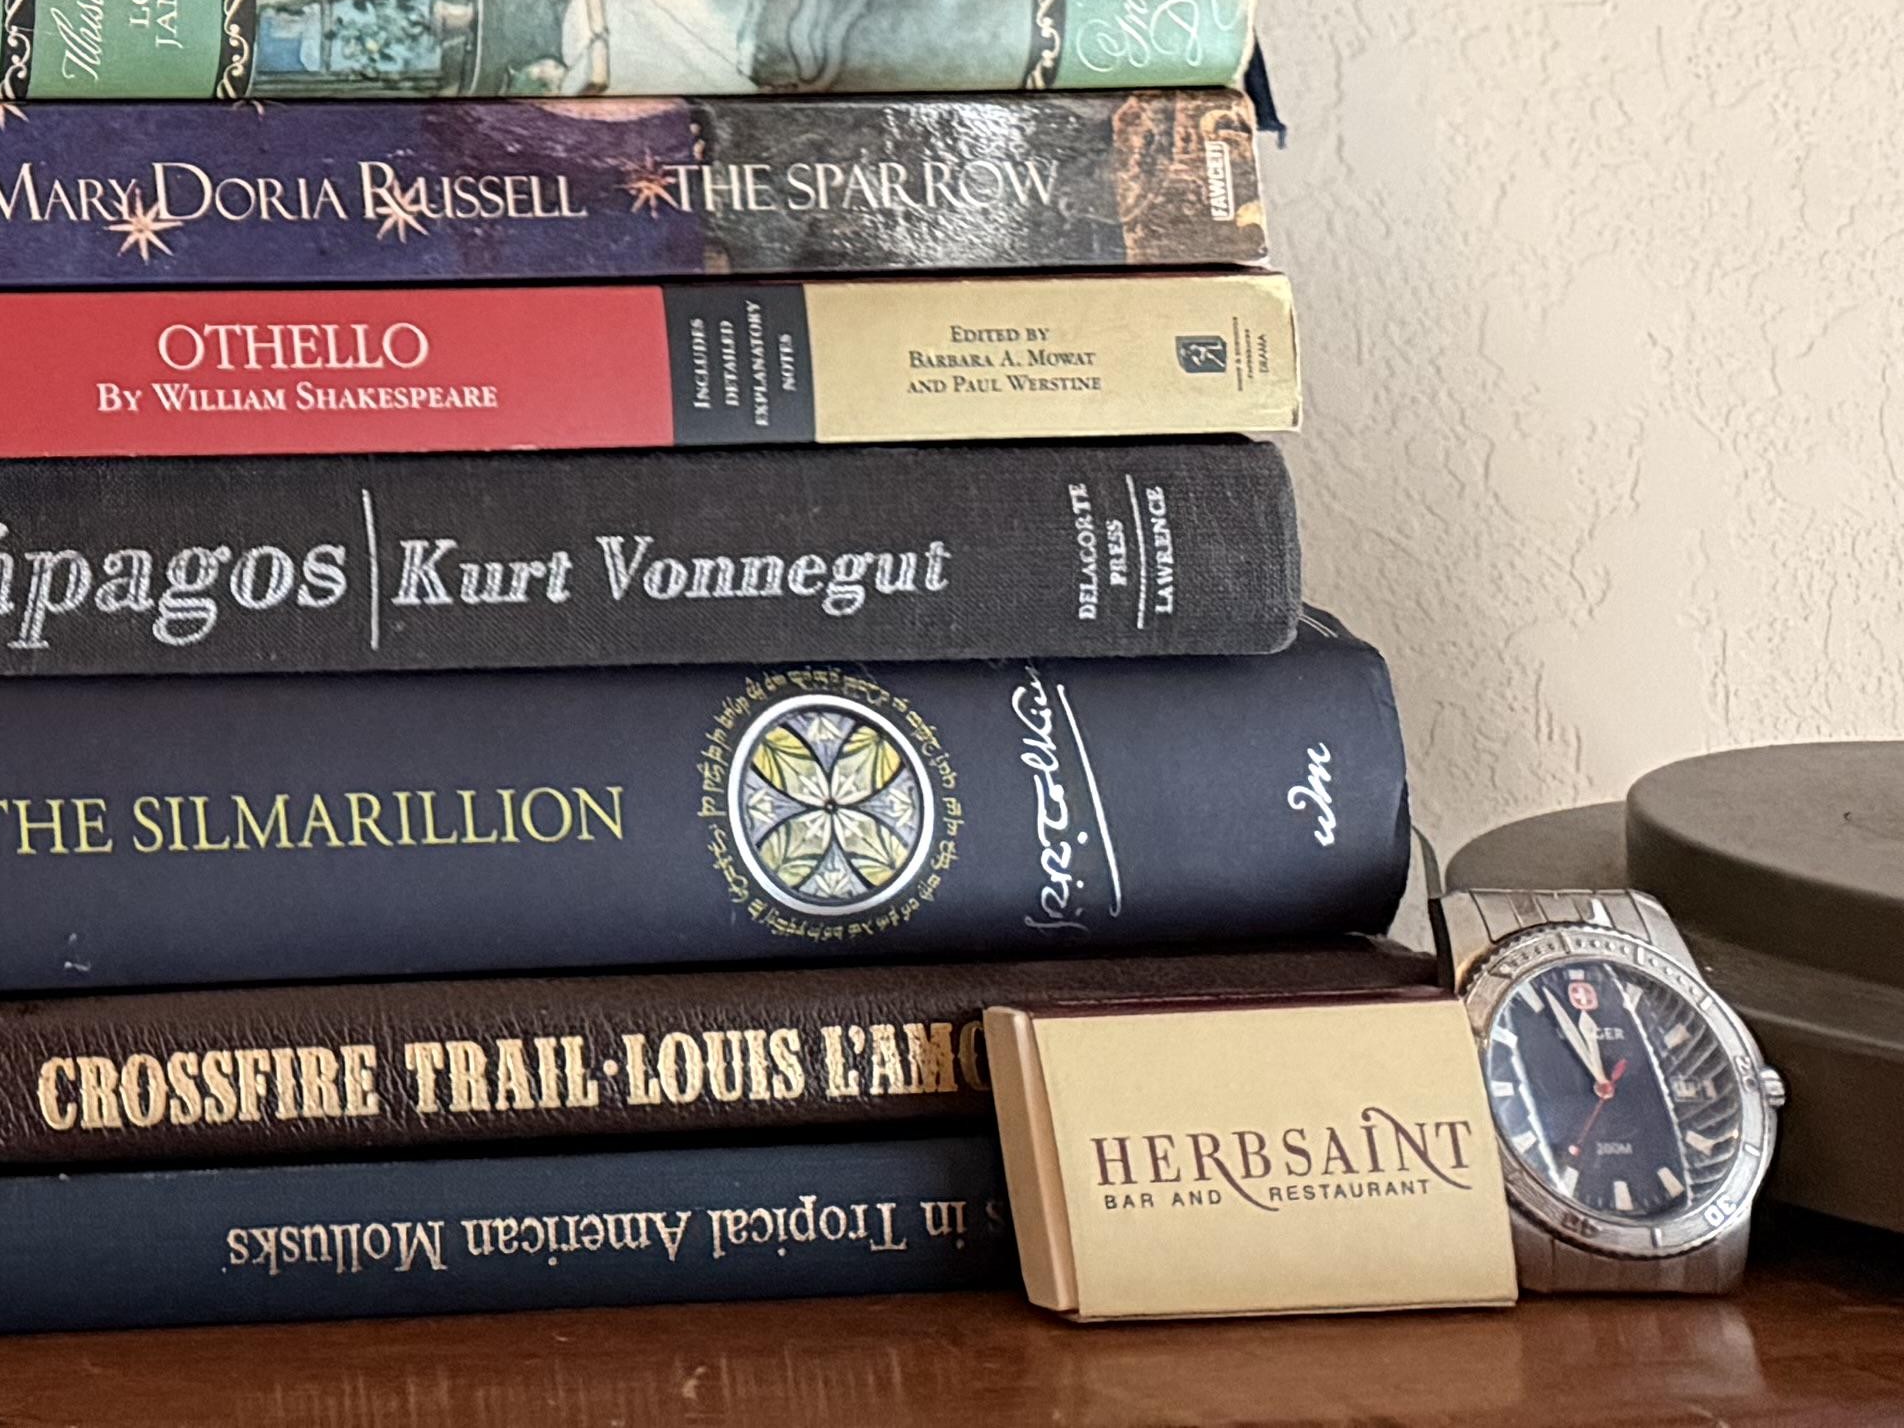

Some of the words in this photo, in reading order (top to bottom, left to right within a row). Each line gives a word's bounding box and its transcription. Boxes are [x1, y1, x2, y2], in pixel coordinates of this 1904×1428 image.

[909, 348, 995, 370] BARBARA
[1001, 350, 1021, 369] A.
[1027, 350, 1097, 370] MOWAT
[951, 325, 1019, 346] EDITED
[1026, 326, 1050, 345] BY
[907, 376, 948, 395] AND
[954, 375, 1001, 394] PAUL
[1008, 373, 1102, 394] WERSTINE
[1068, 481, 1097, 621] DELACORTE
[1107, 519, 1129, 588] PRESS
[1144, 486, 1173, 614] LAWRENCE
[131, 785, 625, 855] SILMARILLION
[1090, 1107, 1474, 1212] HERBSAINT
[920, 1197, 967, 1242] in
[1104, 1193, 1154, 1210] BAR
[1170, 1189, 1222, 1208] AND
[1268, 1178, 1431, 1204] RESTAURANT
[226, 1219, 448, 1275] Mollusks
[462, 1203, 684, 1267] American
[712, 1197, 907, 1255] Tropical
